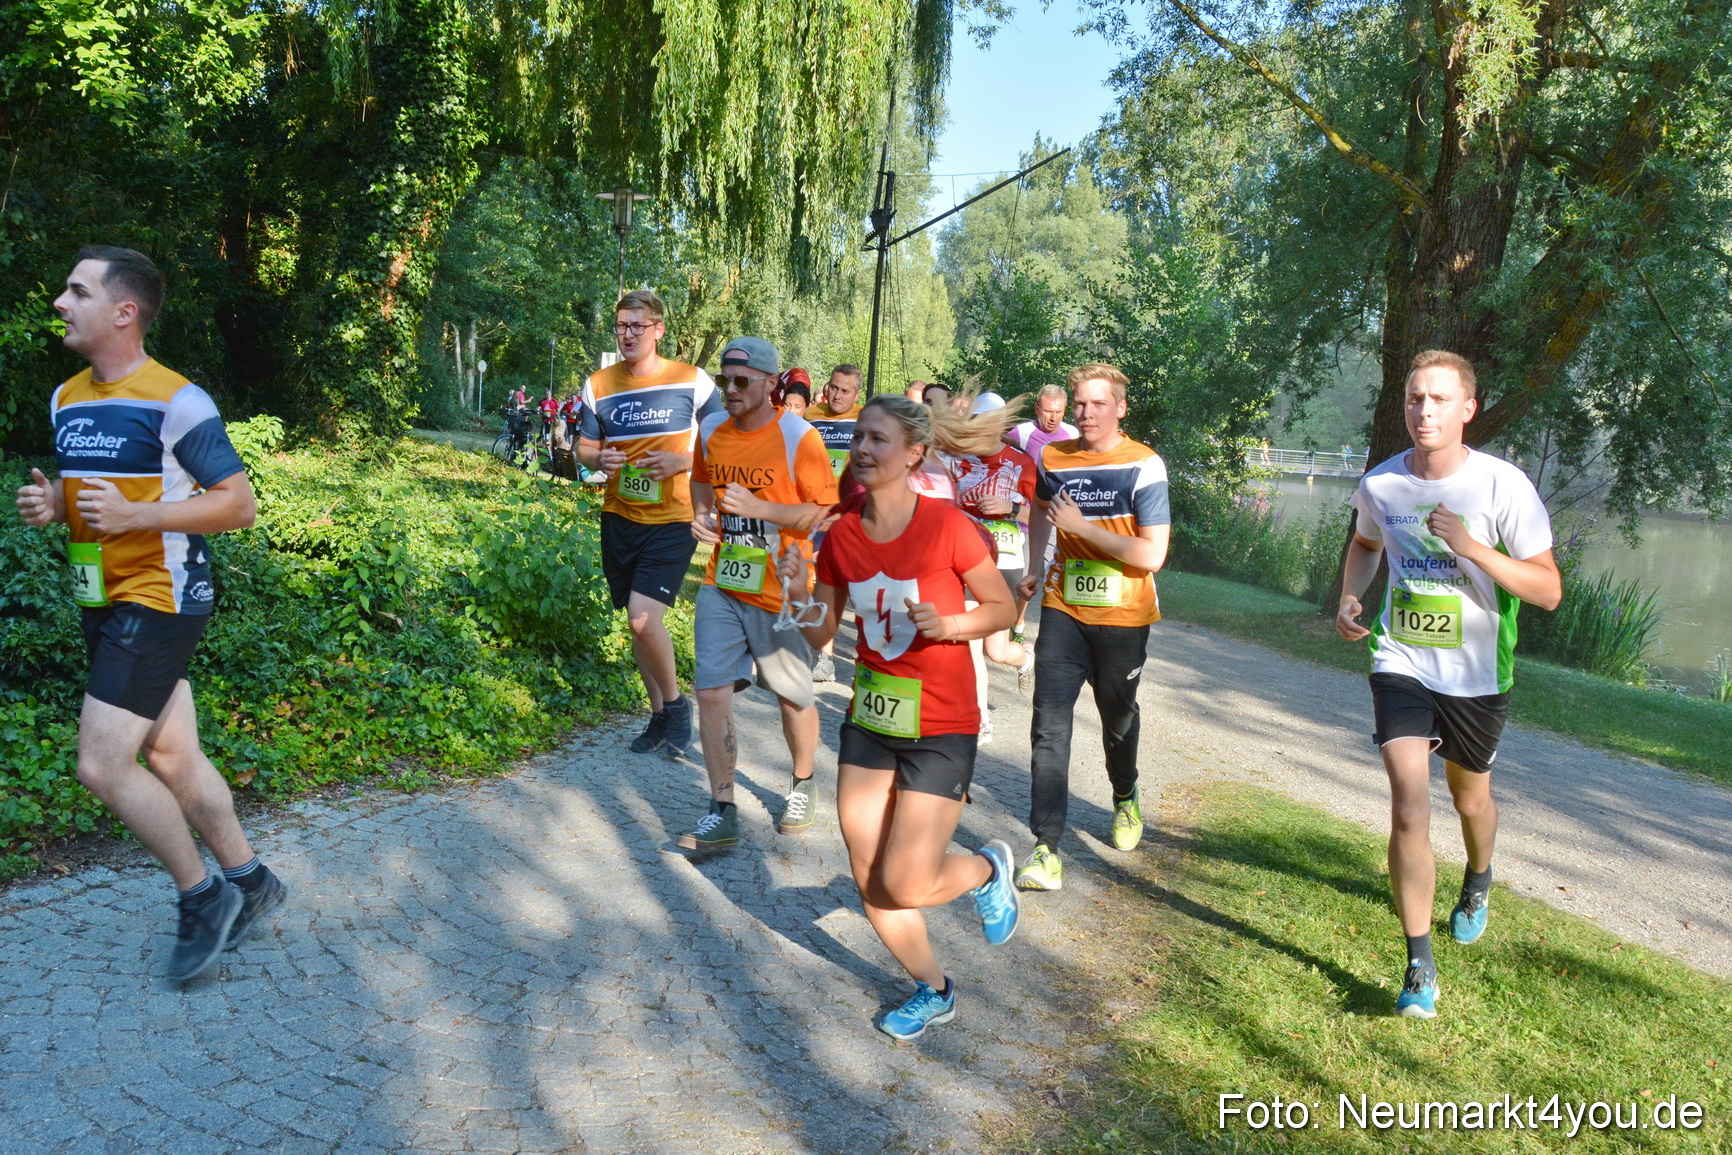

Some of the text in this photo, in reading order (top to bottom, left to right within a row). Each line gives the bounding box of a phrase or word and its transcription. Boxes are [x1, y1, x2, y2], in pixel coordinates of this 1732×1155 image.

[621, 408, 673, 422] Fischer
[626, 418, 670, 427] AUTOMOBILE
[62, 431, 128, 449] Fischer
[65, 449, 118, 458] AUTOMOBILE
[715, 463, 775, 486] WINGS
[624, 477, 651, 492] 580
[1069, 488, 1119, 501] Fischer
[1386, 515, 1419, 525] BERATA
[721, 559, 751, 579] 203
[1401, 556, 1458, 571] Laufend
[1075, 575, 1108, 593] 604
[1398, 608, 1451, 633] 1022
[863, 691, 901, 719] 407
